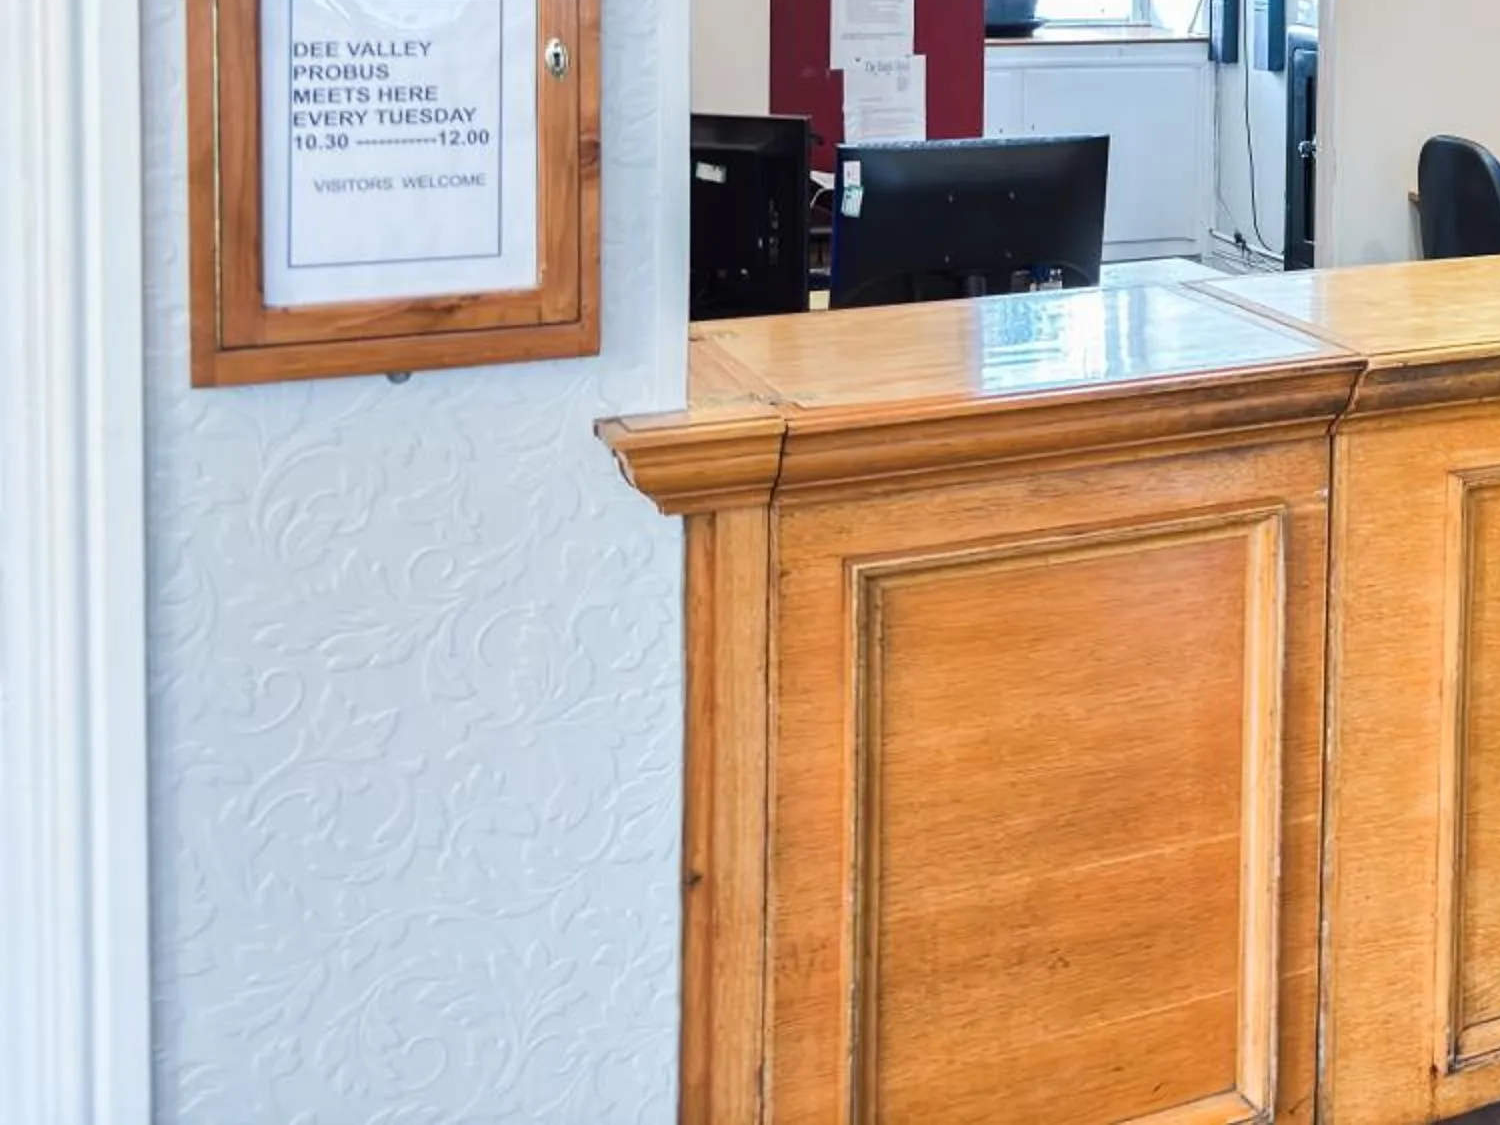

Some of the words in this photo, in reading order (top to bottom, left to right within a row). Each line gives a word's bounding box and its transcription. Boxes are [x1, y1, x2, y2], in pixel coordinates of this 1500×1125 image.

[293, 41, 339, 58] DEE
[347, 41, 432, 58] VALLEY
[293, 64, 390, 81] PROBUS
[293, 88, 370, 104] MEETS
[378, 86, 438, 102] HERE
[293, 110, 368, 127] EVERY
[377, 107, 477, 125] TUESDAY
[294, 134, 349, 150] 10.30
[313, 176, 393, 193] VISITORS
[402, 173, 486, 189] WELCOME
